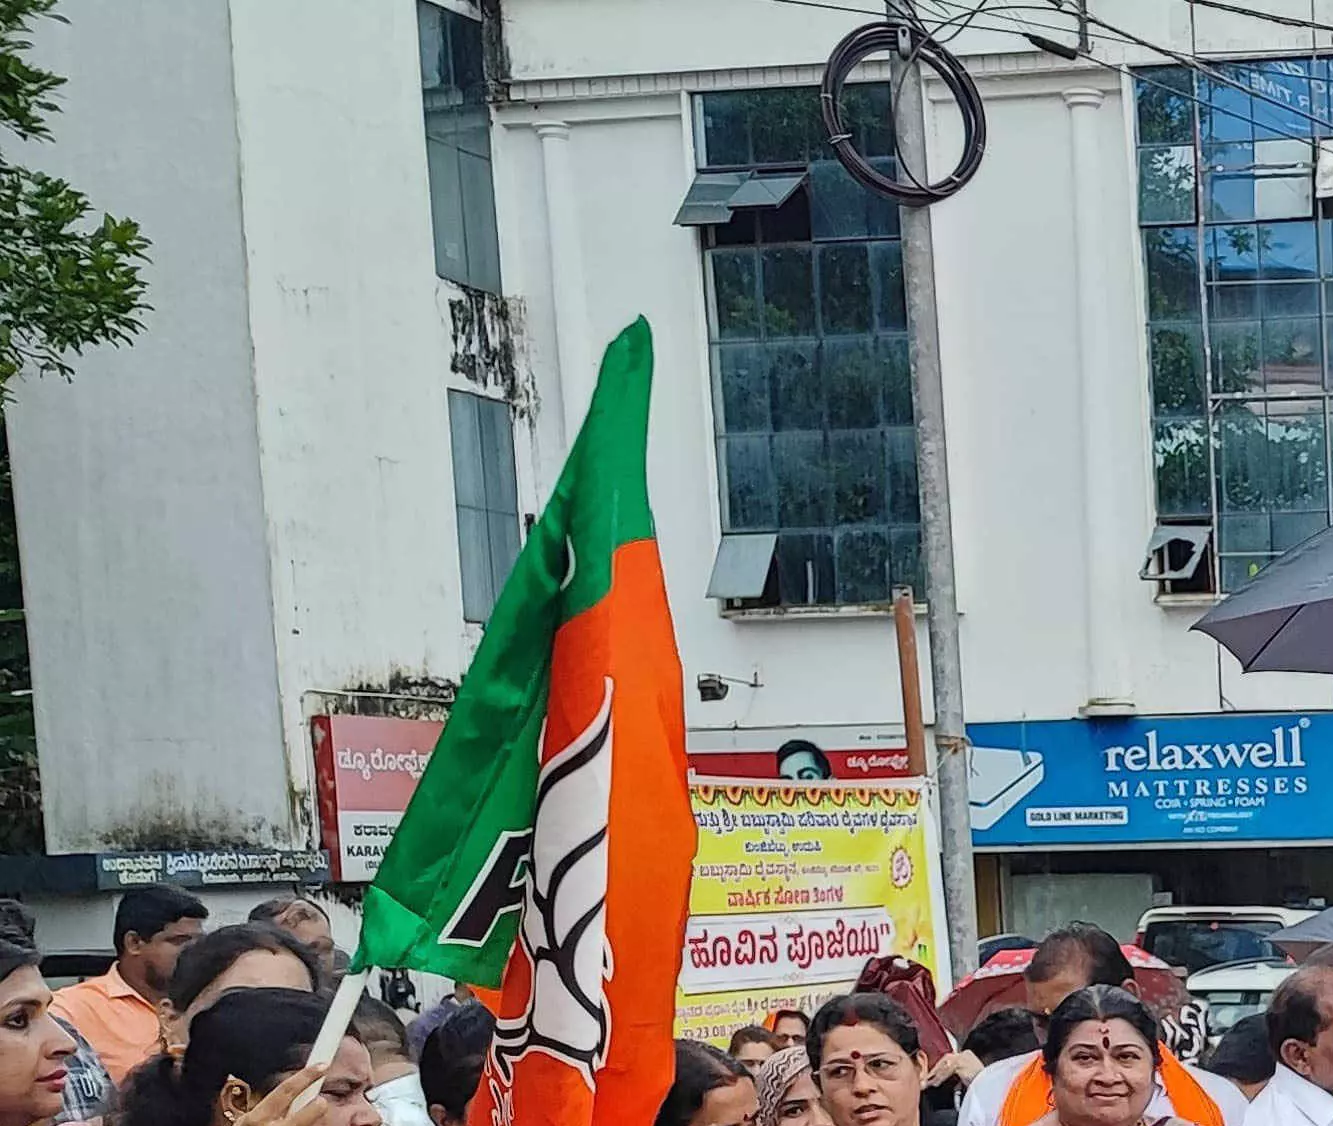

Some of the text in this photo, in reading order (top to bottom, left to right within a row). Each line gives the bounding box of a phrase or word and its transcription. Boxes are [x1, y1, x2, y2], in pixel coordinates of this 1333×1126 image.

[1103, 726, 1307, 773] relaxwell
[1107, 776, 1309, 799] MATTRESSES
[1189, 797, 1227, 809] SPRING
[1234, 796, 1266, 808] FOAM
[1029, 810, 1125, 822] GOLD LINE MARKETING
[347, 845, 387, 857] KARAV
[688, 925, 778, 969] ಹೂವಿನ
